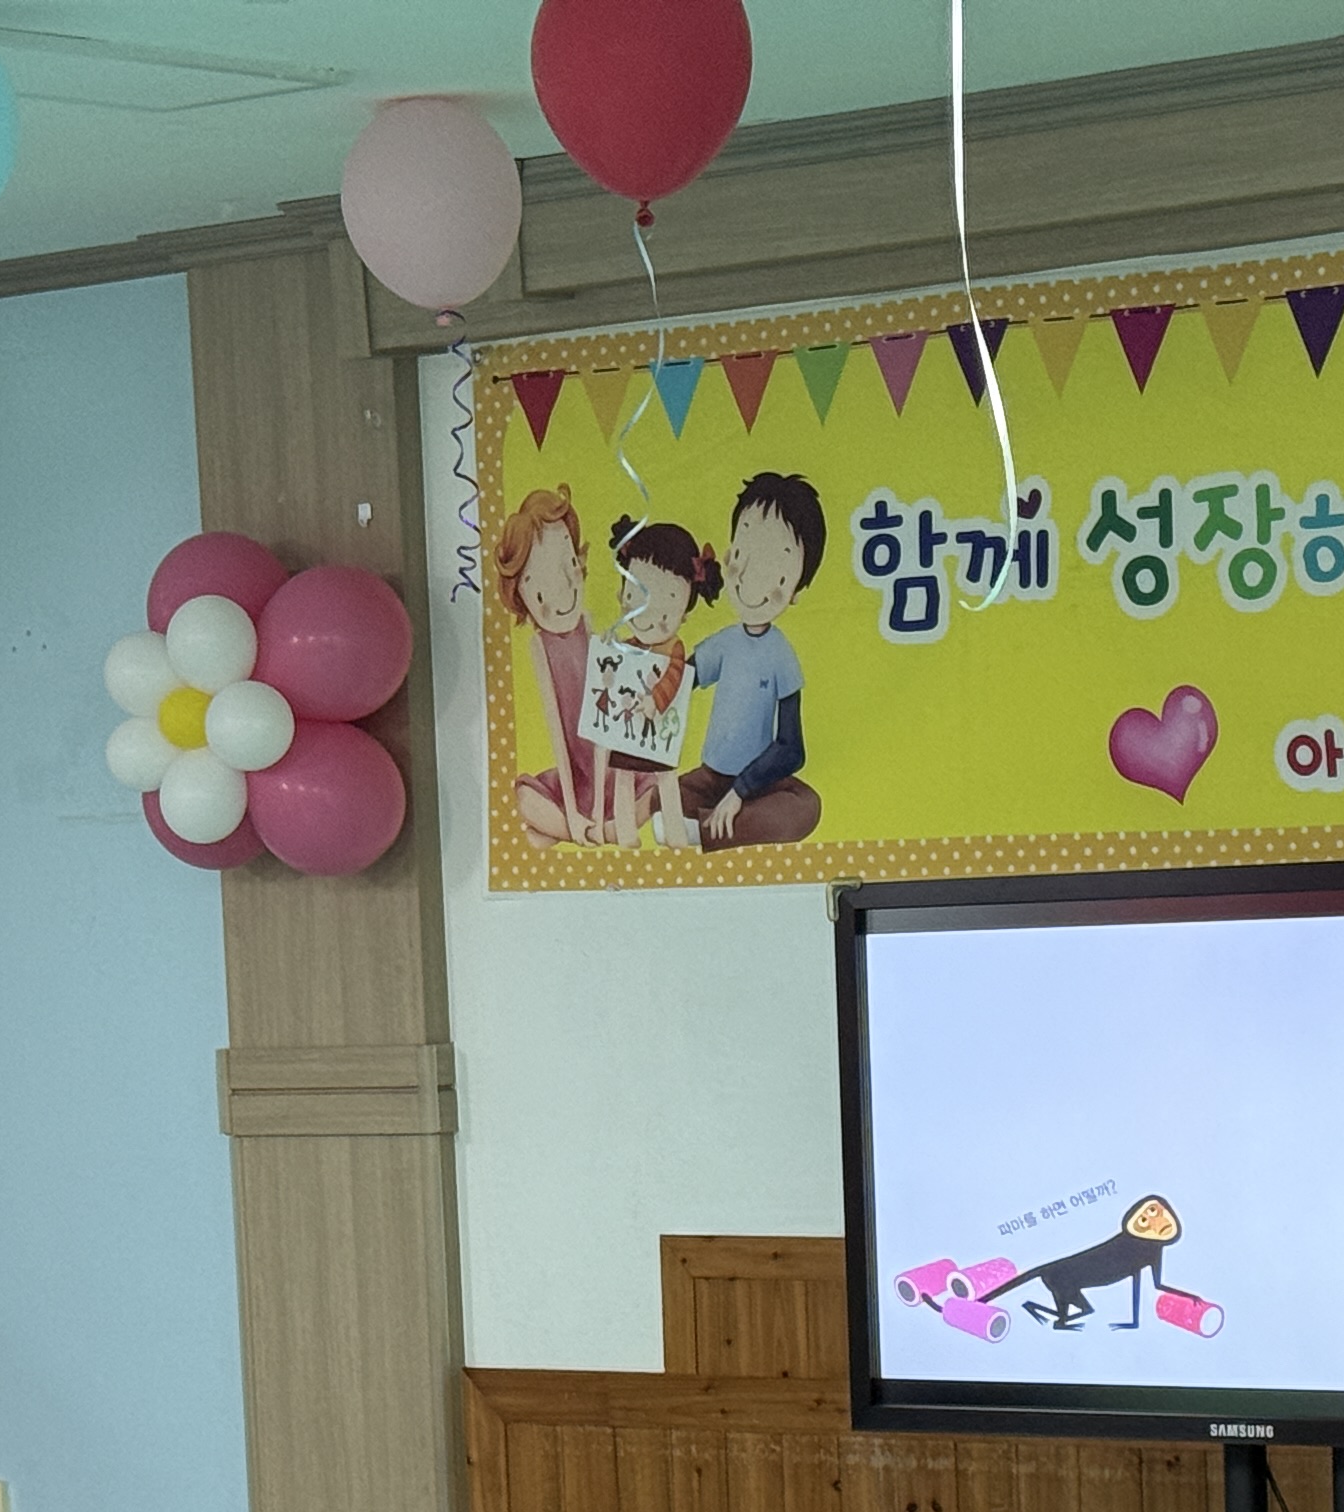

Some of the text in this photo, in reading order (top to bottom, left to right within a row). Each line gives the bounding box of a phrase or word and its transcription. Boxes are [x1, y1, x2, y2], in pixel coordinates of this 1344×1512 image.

[859, 499, 1050, 633] 함께
[1040, 1200, 1068, 1219] 하면
[1209, 1423, 1274, 1438] SAMSUNG
